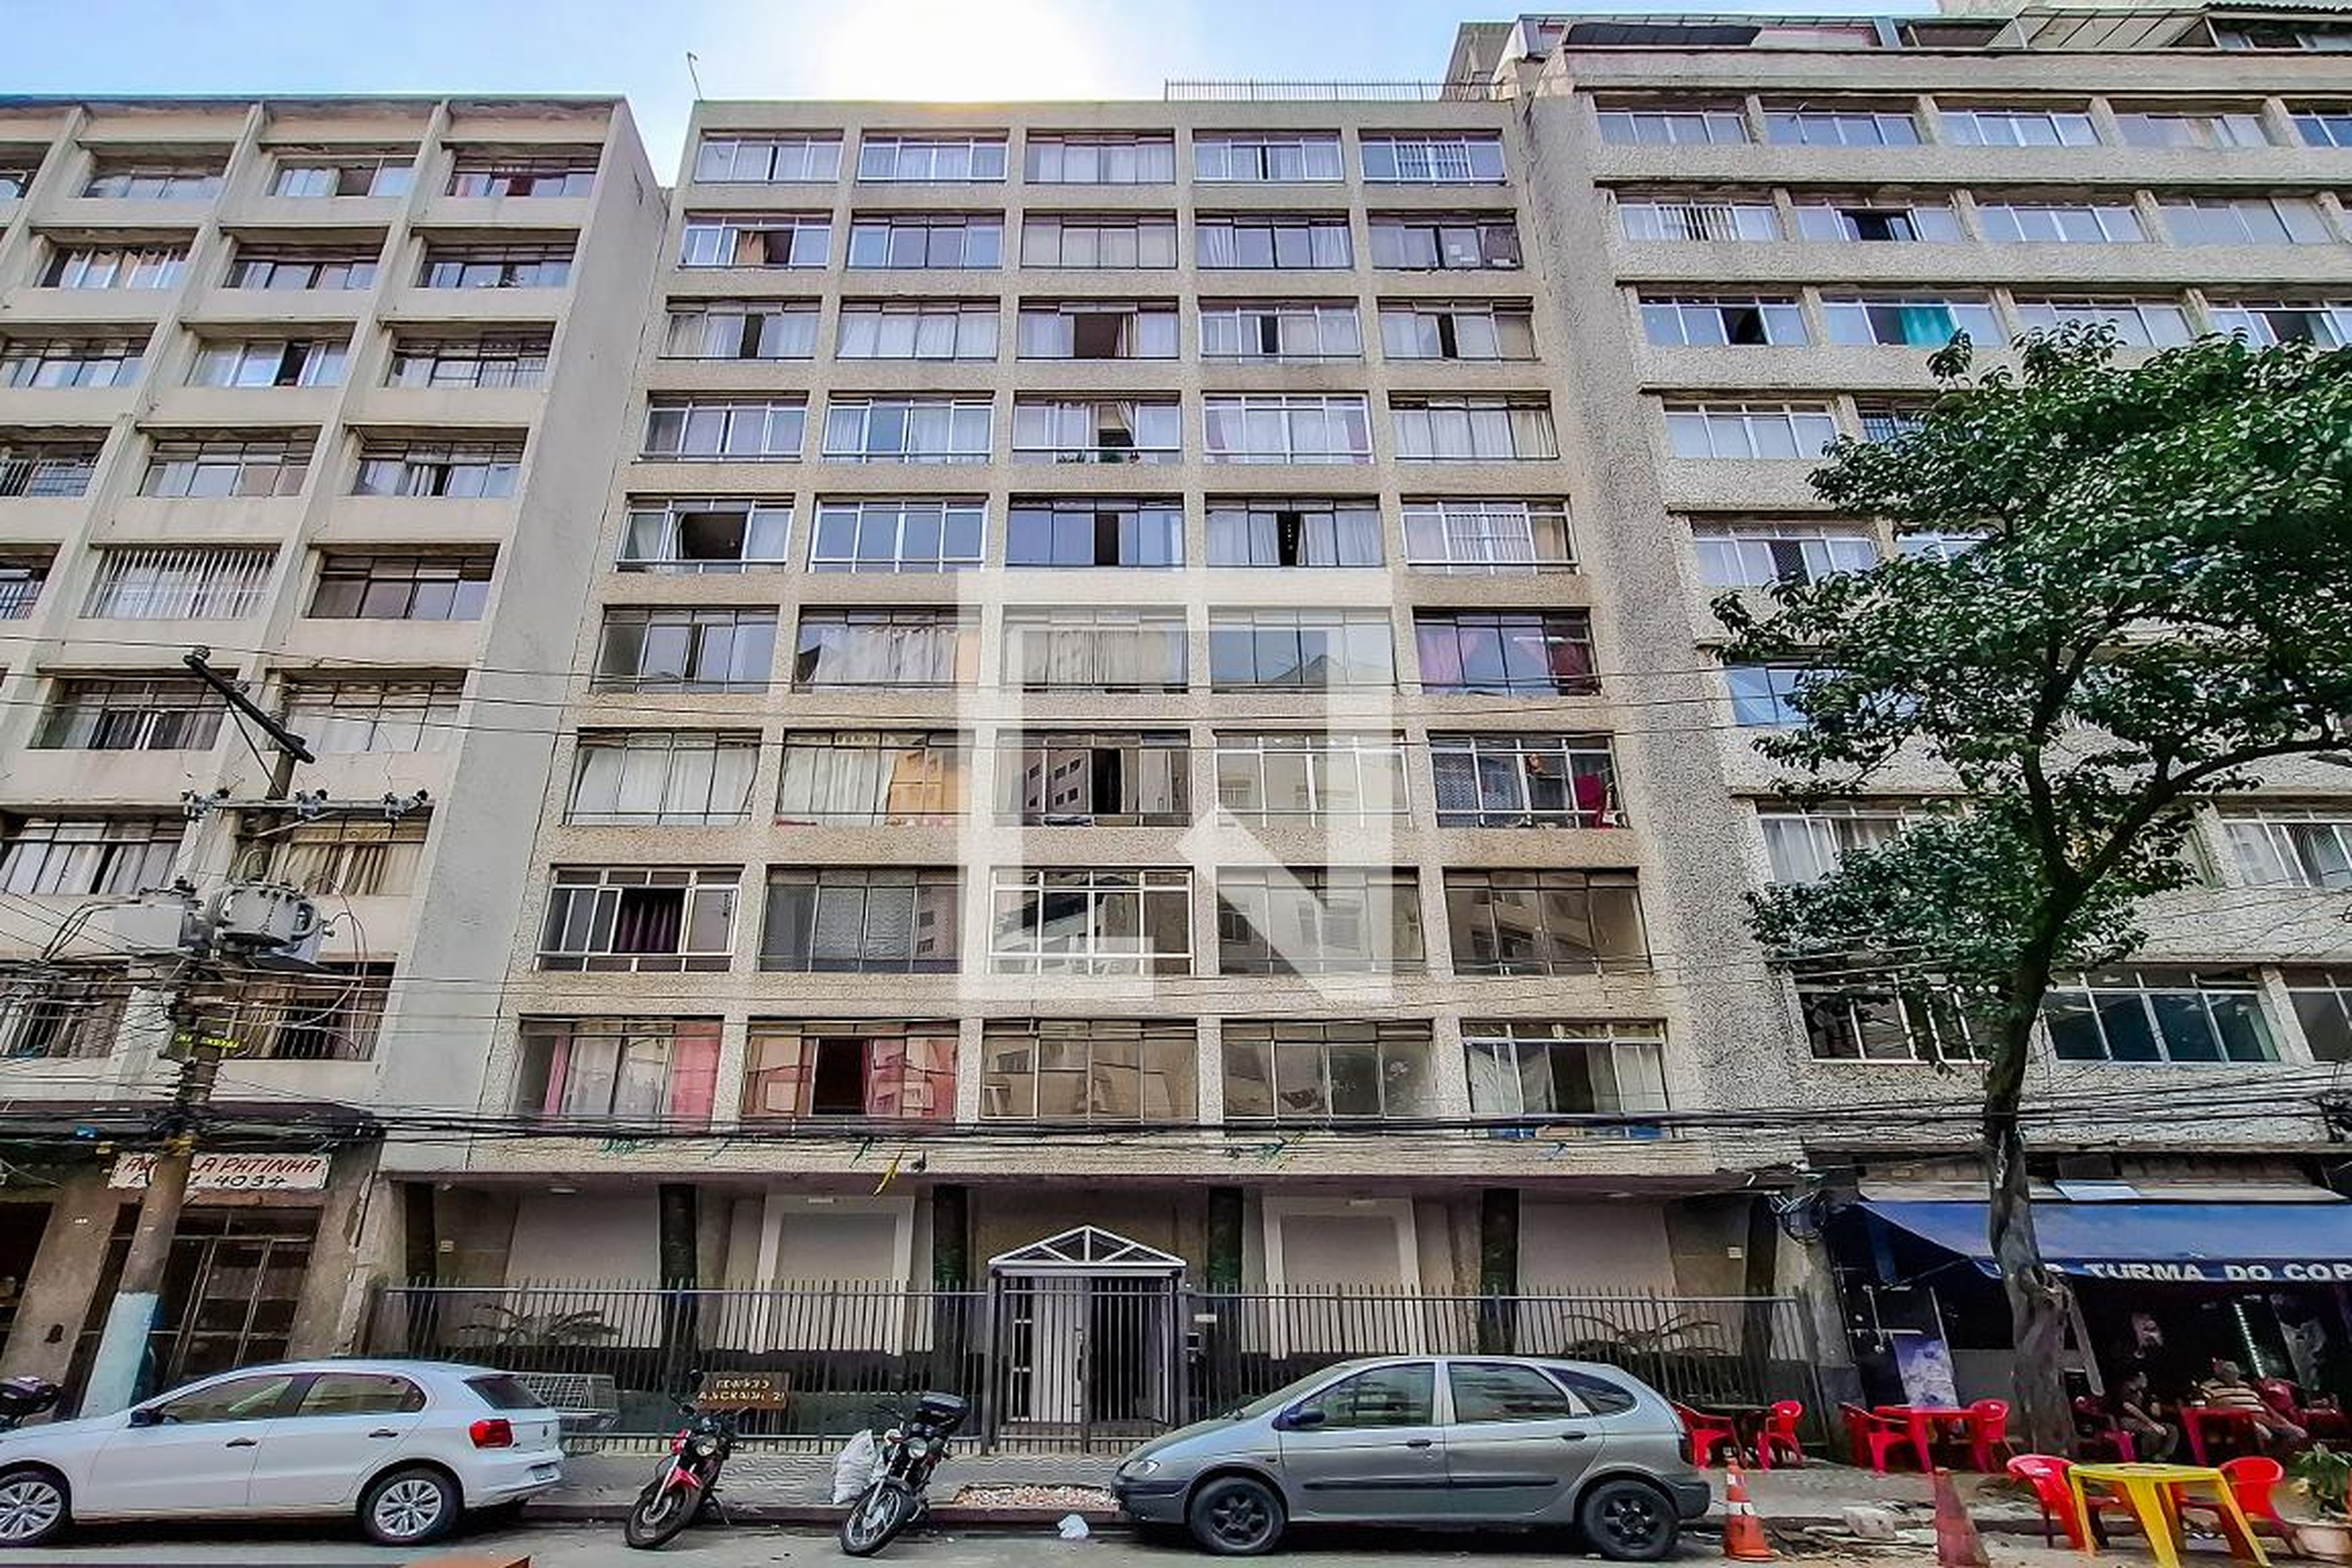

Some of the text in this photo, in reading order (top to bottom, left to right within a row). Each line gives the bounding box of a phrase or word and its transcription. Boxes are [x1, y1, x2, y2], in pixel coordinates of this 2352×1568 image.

[218, 1157, 321, 1173] PATINHA
[2084, 1263, 2206, 1280] TURMA
[2223, 1264, 2272, 1281] DO
[2283, 1263, 2352, 1281] COP
